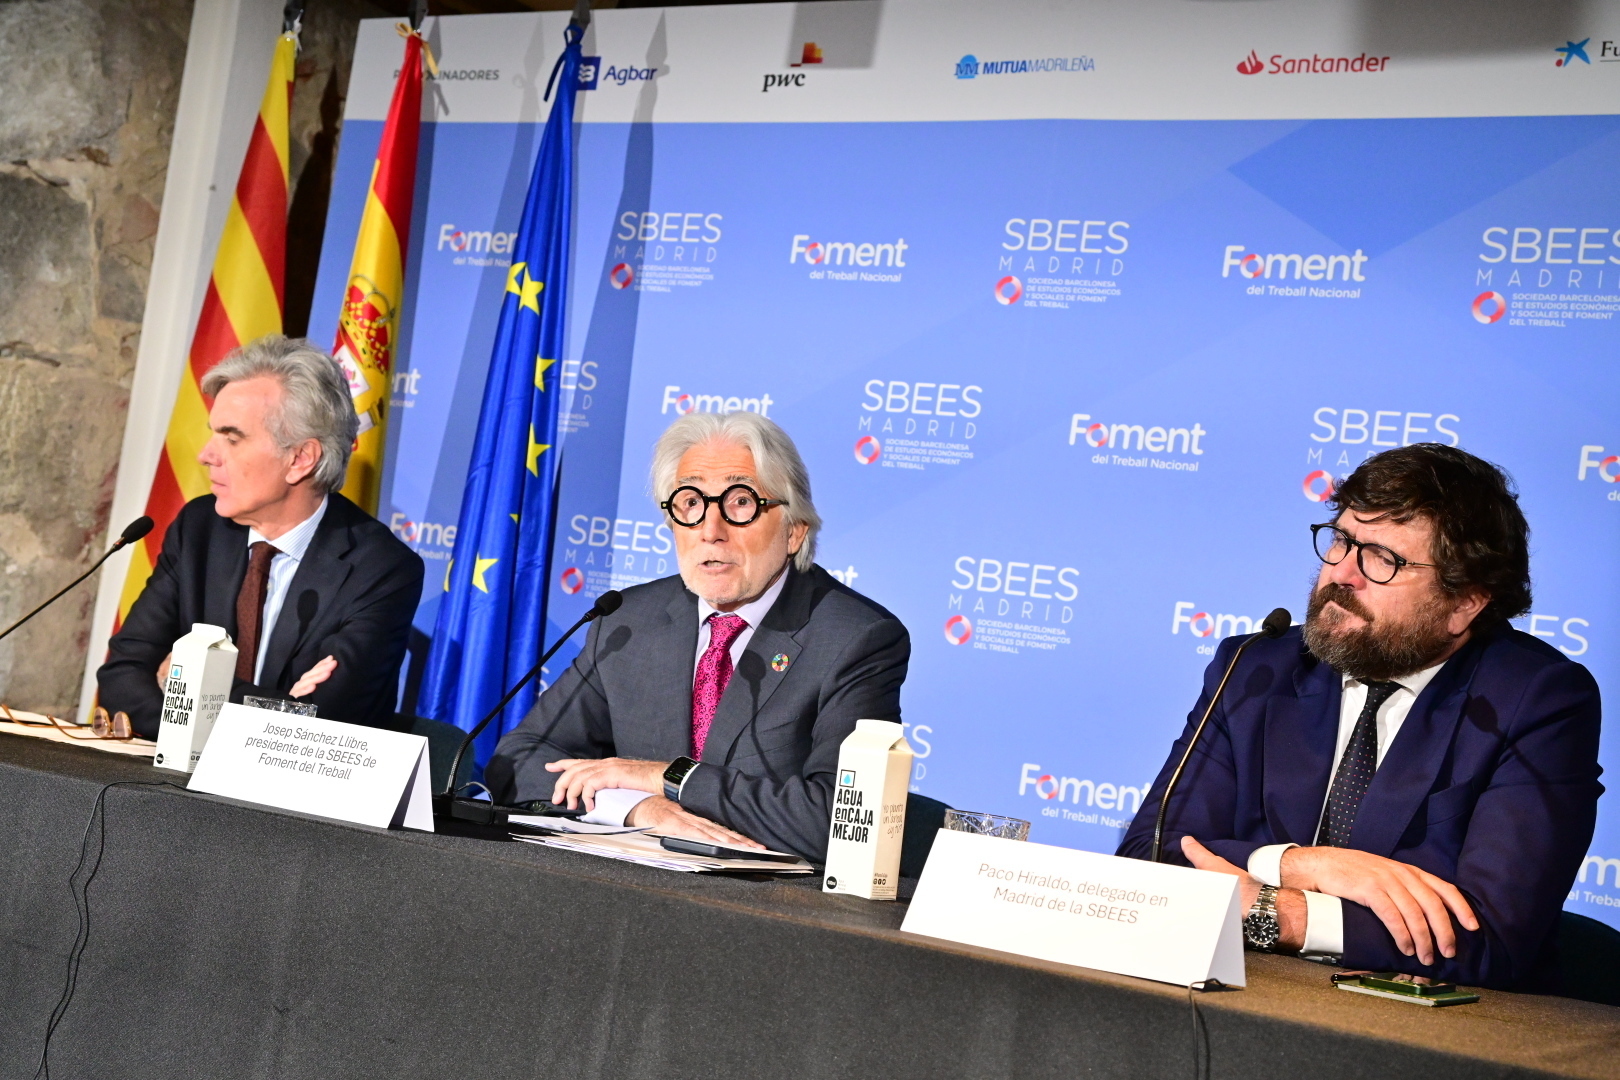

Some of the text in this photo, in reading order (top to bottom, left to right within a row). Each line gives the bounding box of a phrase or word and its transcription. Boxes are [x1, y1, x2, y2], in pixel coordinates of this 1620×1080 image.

[982, 55, 1095, 75] MUTUAMADRILEÑA
[1268, 52, 1390, 75] Santander
[603, 64, 658, 86] Agbar
[761, 73, 806, 93] pwc
[617, 211, 723, 243] SBEES
[1002, 218, 1130, 254] SBEES
[614, 244, 717, 262] MADRID
[790, 234, 908, 267] Foment
[999, 256, 1124, 276] MADRID
[1222, 245, 1368, 282] Foment
[809, 270, 902, 282] del Treball Nacional
[1065, 278, 1116, 287] BARCELONESA
[1476, 268, 1620, 289] MADRI
[1246, 285, 1361, 298] del Treball Nacional
[1512, 293, 1557, 301] SOCIEDAD
[1518, 310, 1559, 318] SOCIALES
[1525, 302, 1568, 310] ESTUDIOS
[1570, 302, 1620, 311] ECONÓMIC
[1509, 318, 1566, 327] DEL TREBALL
[661, 385, 774, 418] Foment
[861, 379, 983, 418] SBEES
[858, 415, 976, 439] MADRID
[1069, 413, 1206, 455] Foment
[1310, 407, 1460, 447] SBEES
[885, 438, 969, 450] SOCIEDAD BARCELONESA
[895, 447, 927, 455] ESTUDIOS
[889, 453, 920, 461] SOCIALES
[932, 457, 961, 465] FOMENT
[896, 461, 925, 470] TREBALL
[1091, 454, 1199, 471] del Treball Nacional
[390, 512, 458, 547] Fome
[568, 514, 672, 554] SBEES
[564, 548, 667, 574] MADRID
[951, 556, 1080, 602] SBEES
[949, 593, 1074, 624] MADRID
[977, 619, 1066, 636] SOCIEDAD BARCELONESA
[987, 628, 1021, 638] ESTUDIOS
[973, 642, 1019, 654] DEL TREBALL
[981, 635, 1014, 645] SOCIALES
[1027, 640, 1057, 650] FOMENT
[1196, 644, 1214, 656] del
[167, 680, 187, 696] AGUA
[165, 696, 193, 712] enCAJA
[162, 709, 189, 726] MEJOR
[263, 722, 369, 752] Josep Sánchez Llibre,
[245, 736, 377, 768] presidente de la SBEES de
[258, 752, 352, 780] Foment del Treball
[836, 788, 863, 807] AGUA
[834, 807, 873, 826] enCAJA
[1042, 806, 1131, 829] del Treball Nacio
[832, 822, 869, 843] MEJOR
[978, 863, 1168, 907] Paco Hiraldo, delegado en
[993, 886, 1139, 924] Madrid de la SBEES
[1567, 890, 1620, 908] el Treba
